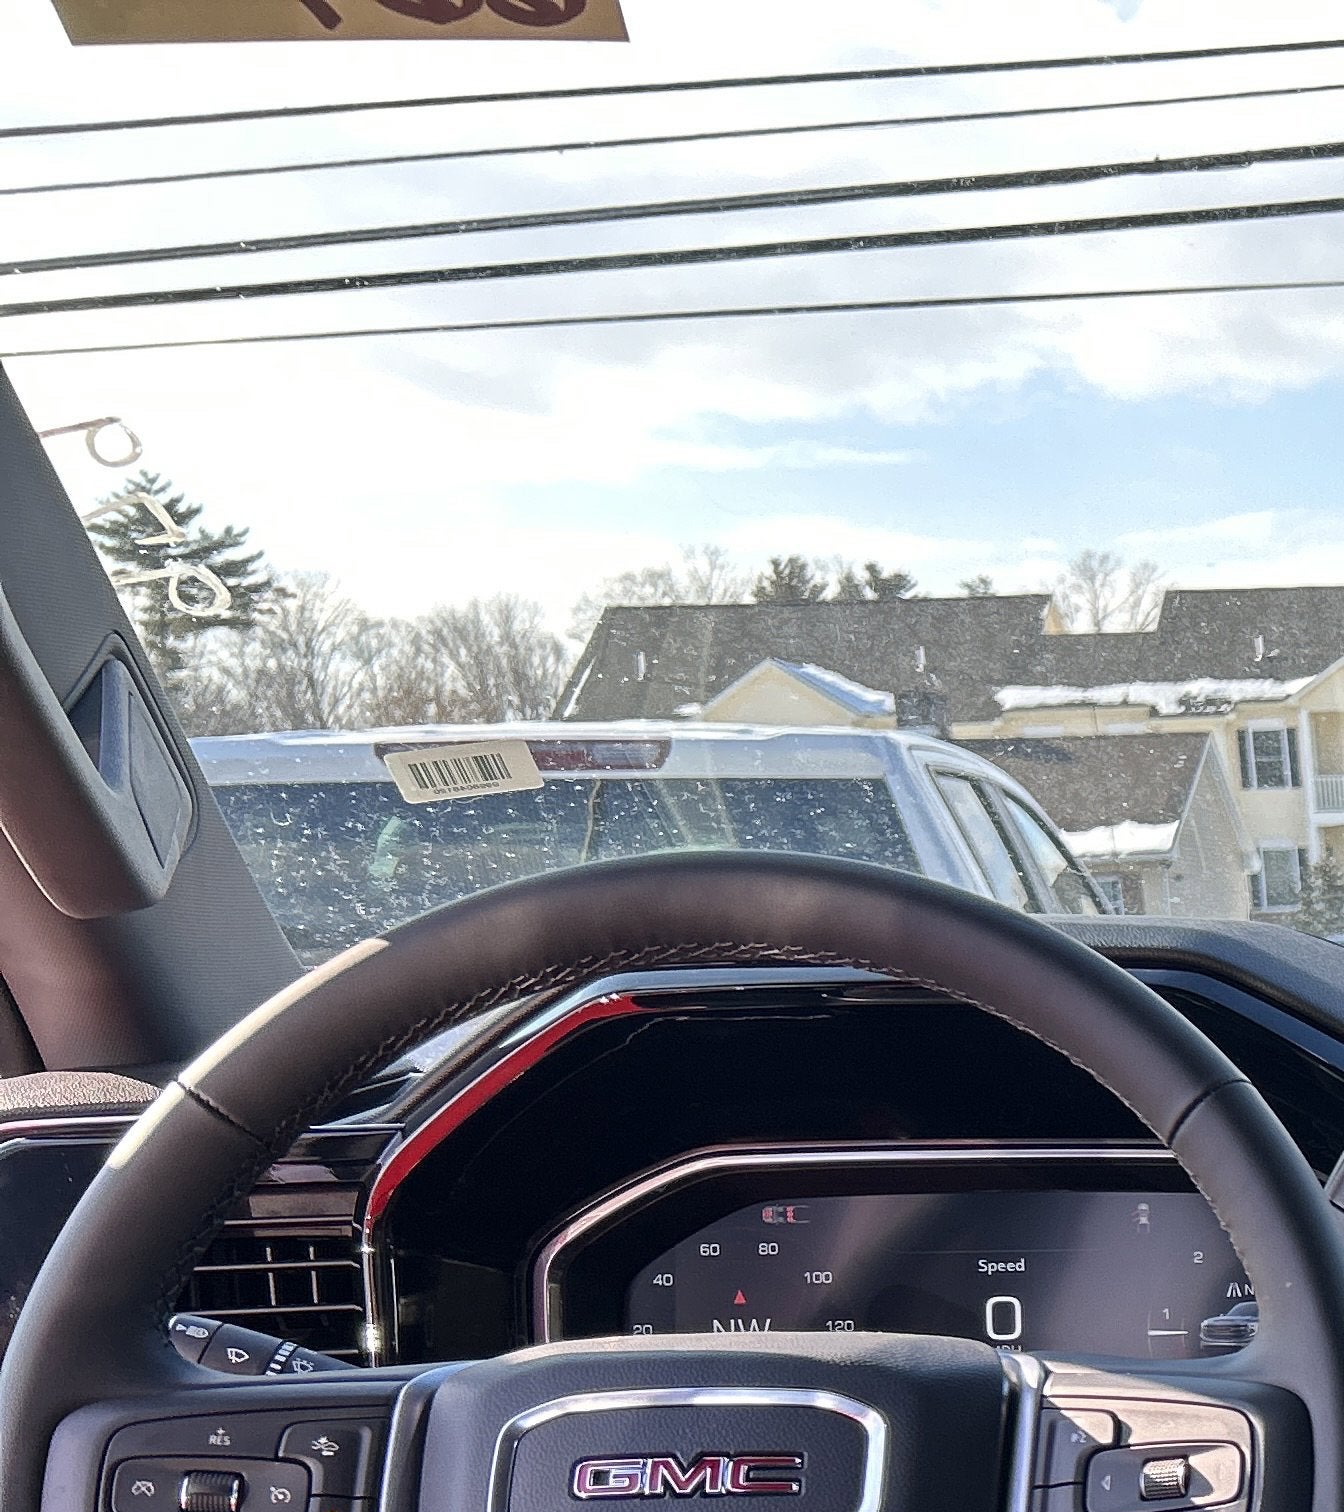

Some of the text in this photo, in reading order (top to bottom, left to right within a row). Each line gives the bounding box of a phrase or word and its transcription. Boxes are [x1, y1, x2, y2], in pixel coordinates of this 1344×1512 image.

[700, 1243, 720, 1256] 60
[758, 1243, 778, 1255] 80
[1193, 1251, 1204, 1264] 2
[978, 1258, 1025, 1274] Speed
[652, 1274, 673, 1287] 40
[804, 1271, 833, 1284] 100
[985, 1296, 1022, 1341] 0
[1163, 1308, 1171, 1320] 1
[633, 1324, 652, 1336] 20
[826, 1320, 855, 1332] 120
[209, 1434, 231, 1446] RES
[573, 1455, 803, 1499] GMC
